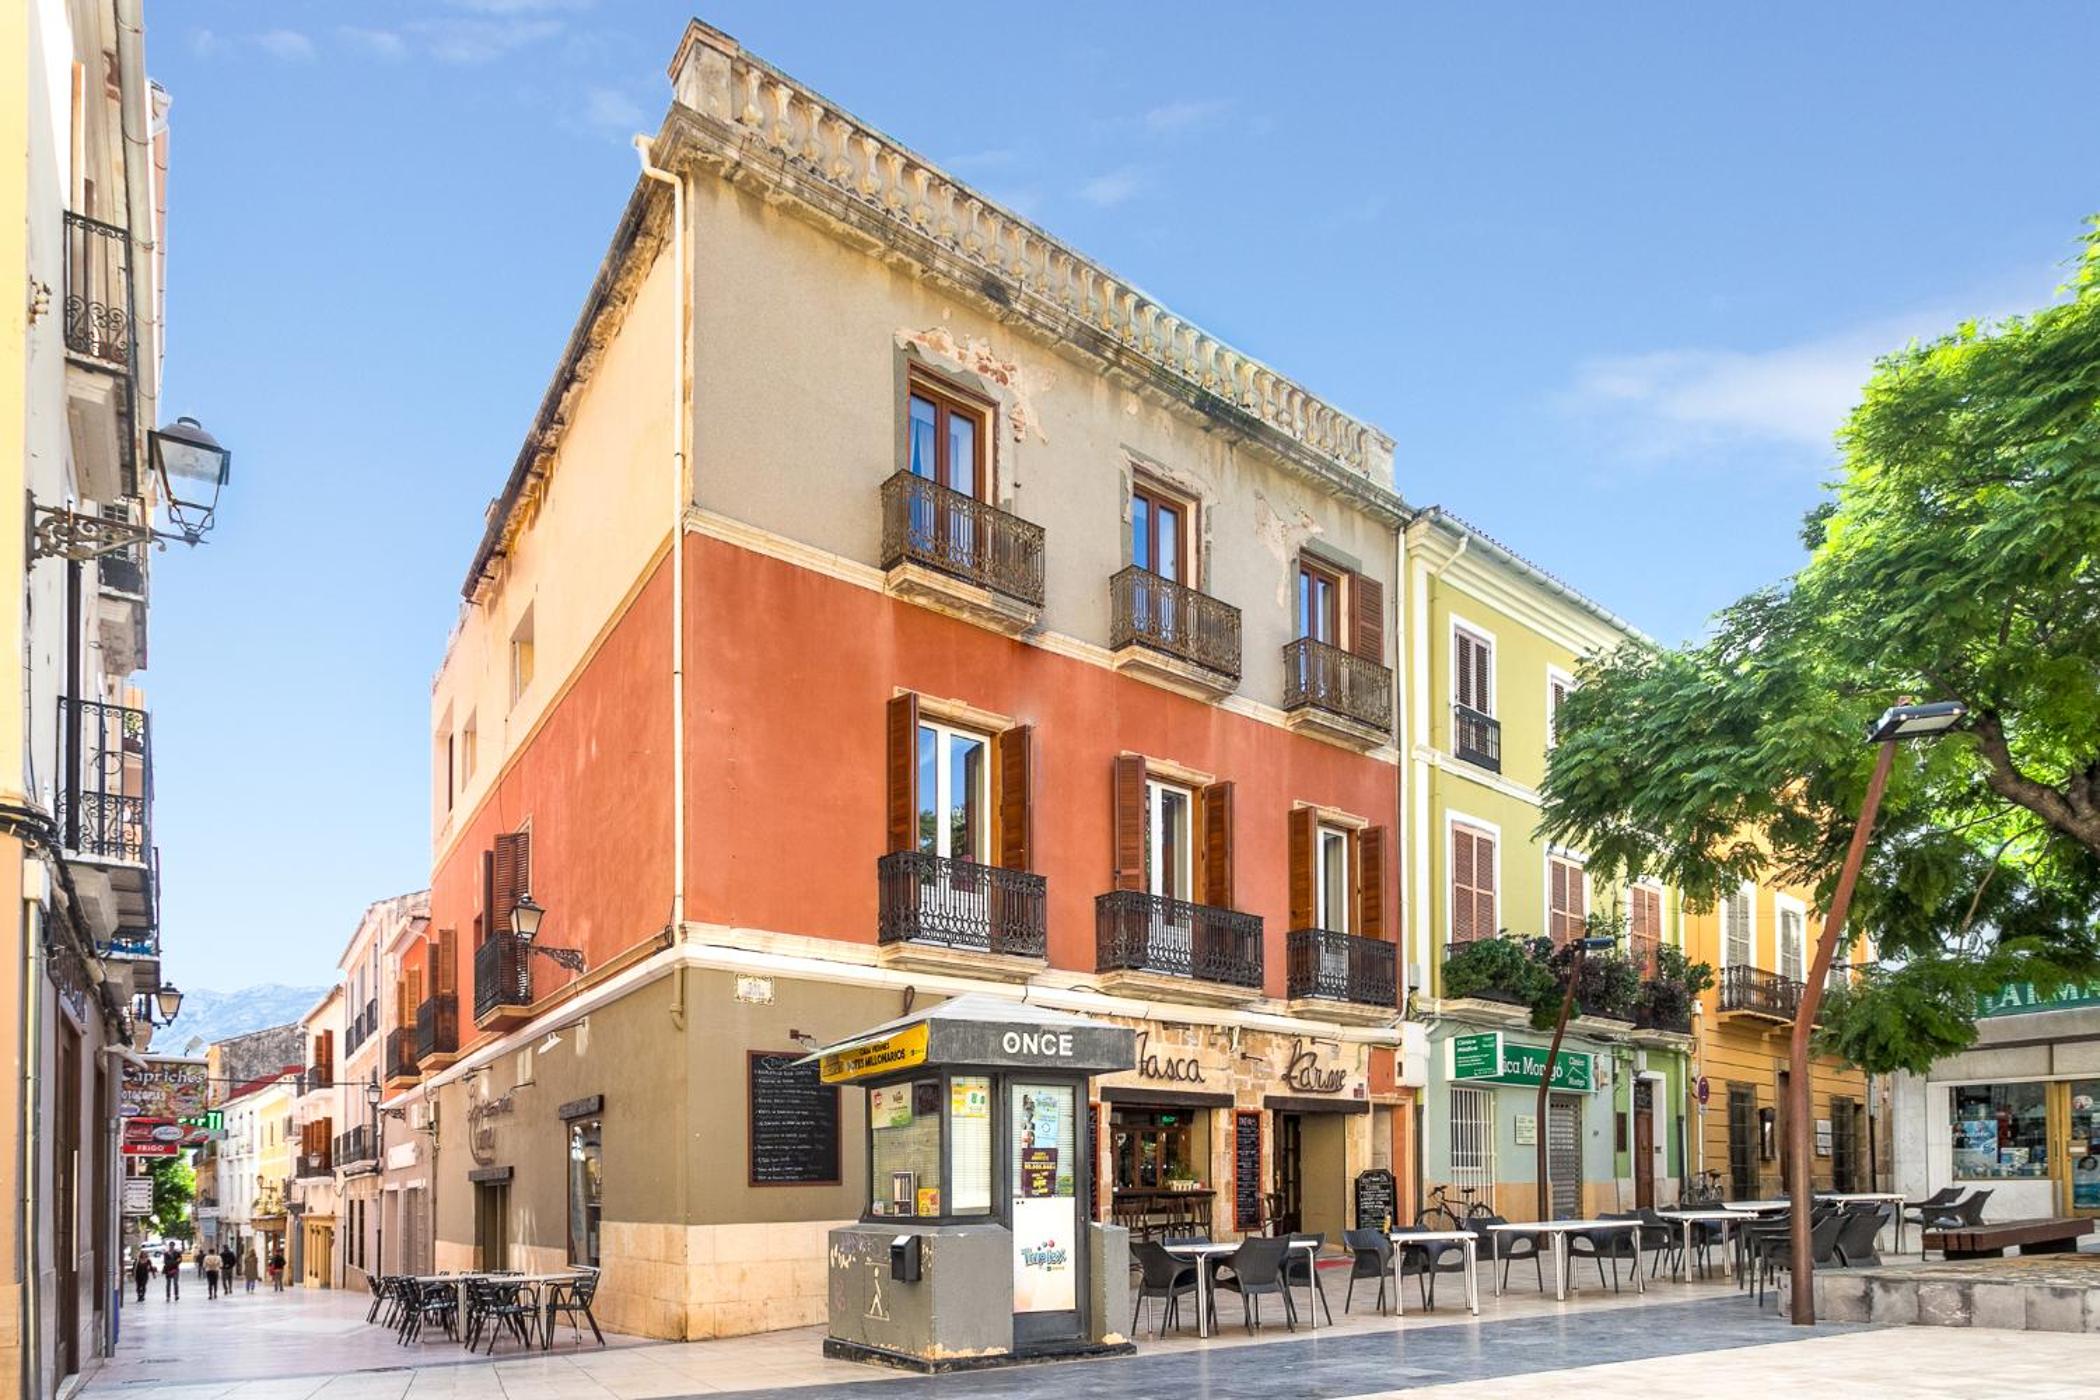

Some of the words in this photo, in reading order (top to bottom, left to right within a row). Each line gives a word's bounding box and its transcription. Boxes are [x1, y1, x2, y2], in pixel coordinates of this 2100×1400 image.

[1003, 1031, 1073, 1056] ONCE
[865, 1047, 906, 1067] MILLONARIOS
[1136, 1031, 1206, 1083] Tasca
[1523, 1056, 1564, 1082] Mongó
